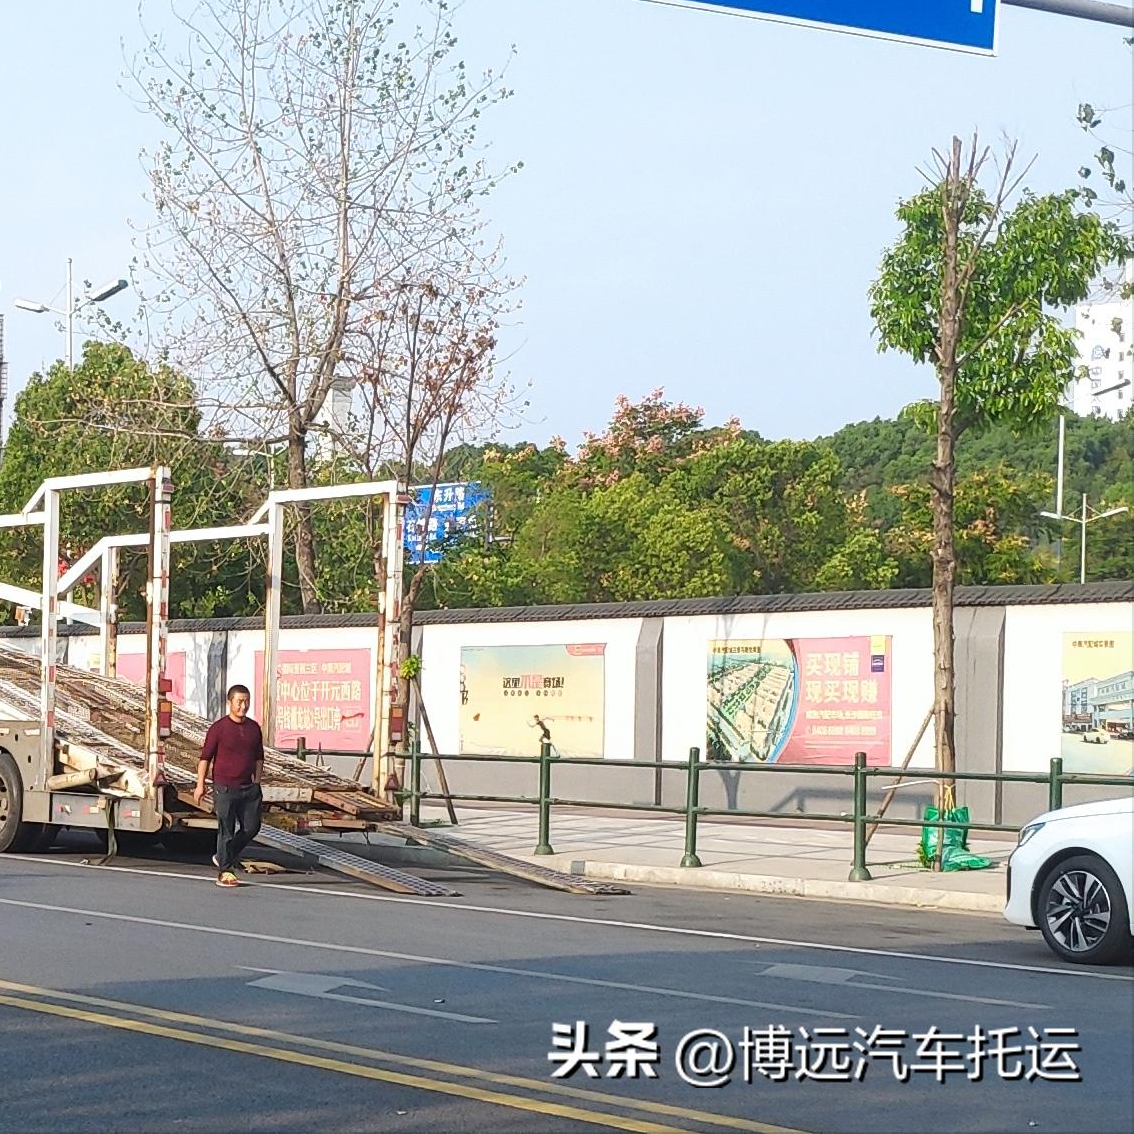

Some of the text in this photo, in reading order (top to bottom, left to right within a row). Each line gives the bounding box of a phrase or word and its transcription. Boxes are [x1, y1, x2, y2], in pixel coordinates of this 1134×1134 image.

[806, 651, 860, 678] 买现铺
[805, 679, 879, 704] 现买现赚
